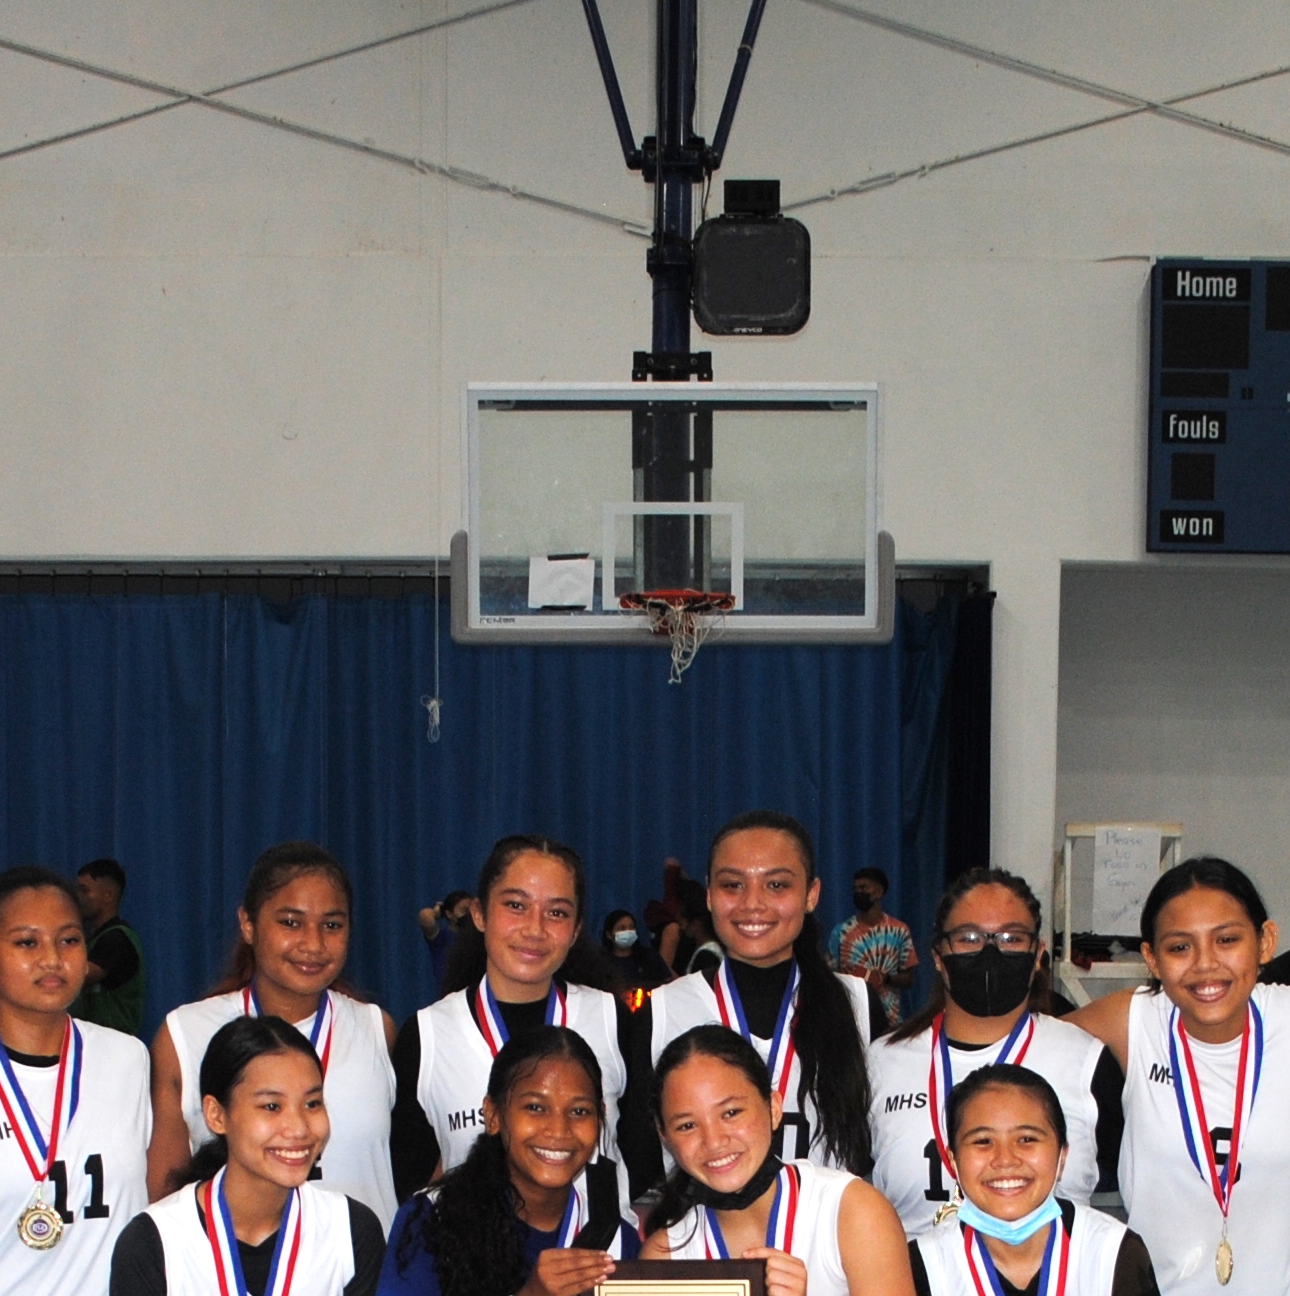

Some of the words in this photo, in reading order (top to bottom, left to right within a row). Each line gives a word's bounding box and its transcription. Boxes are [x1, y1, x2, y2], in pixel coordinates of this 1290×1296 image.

[1176, 271, 1237, 298] Home
[1169, 415, 1220, 439] fouls
[1172, 515, 1214, 537] won
[885, 1092, 928, 1113] MHS
[47, 1153, 109, 1225] 11
